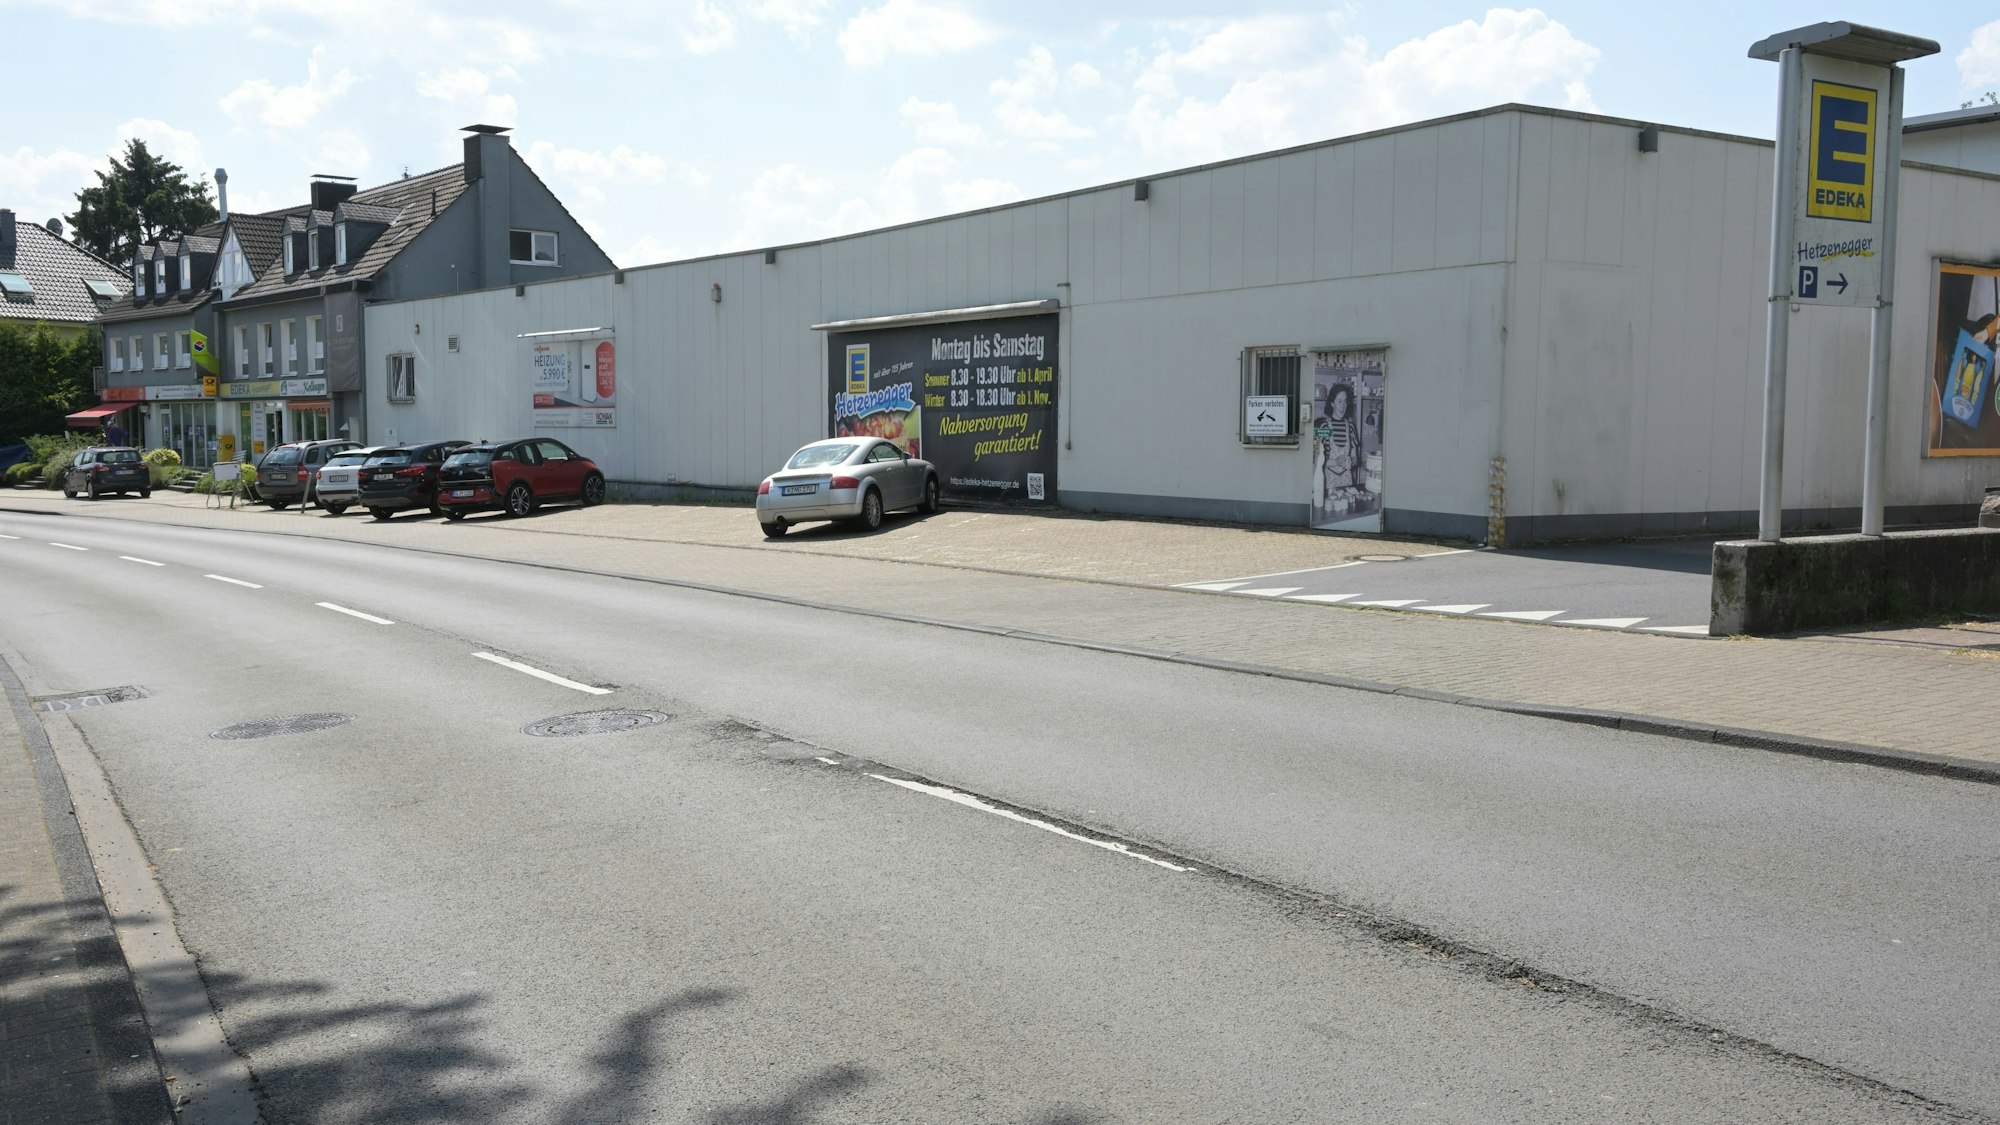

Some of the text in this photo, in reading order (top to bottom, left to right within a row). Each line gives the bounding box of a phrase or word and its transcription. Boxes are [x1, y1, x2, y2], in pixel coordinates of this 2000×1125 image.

[1815, 188, 1866, 209] EDEKA
[1797, 238, 1873, 263] Hetzenegger
[1802, 269, 1814, 295] P
[931, 332, 1045, 365] Montag bis Samstag
[534, 354, 566, 367] HEIZUNG
[543, 368, 560, 380] 5.990
[561, 367, 566, 379] €
[924, 372, 950, 388] Sommer
[950, 367, 969, 386] 8.30
[976, 366, 998, 385] 19.30
[1000, 365, 1016, 384] Uhr
[1016, 368, 1026, 383] ab
[1028, 367, 1033, 383] 1.
[1034, 366, 1053, 386] April
[230, 383, 251, 395] EDEKA
[924, 393, 946, 408] Winter
[950, 389, 969, 407] 8.30
[976, 388, 998, 406] 18.30
[1000, 387, 1016, 406] Uhr
[1016, 390, 1026, 406] ab
[1028, 389, 1033, 405] 1.
[1034, 389, 1052, 405] Nov.
[835, 383, 912, 421] Hetzenegger
[1248, 400, 1263, 408] Parken
[939, 412, 1029, 437] Nahversorgung
[974, 429, 1042, 462] garantiert!
